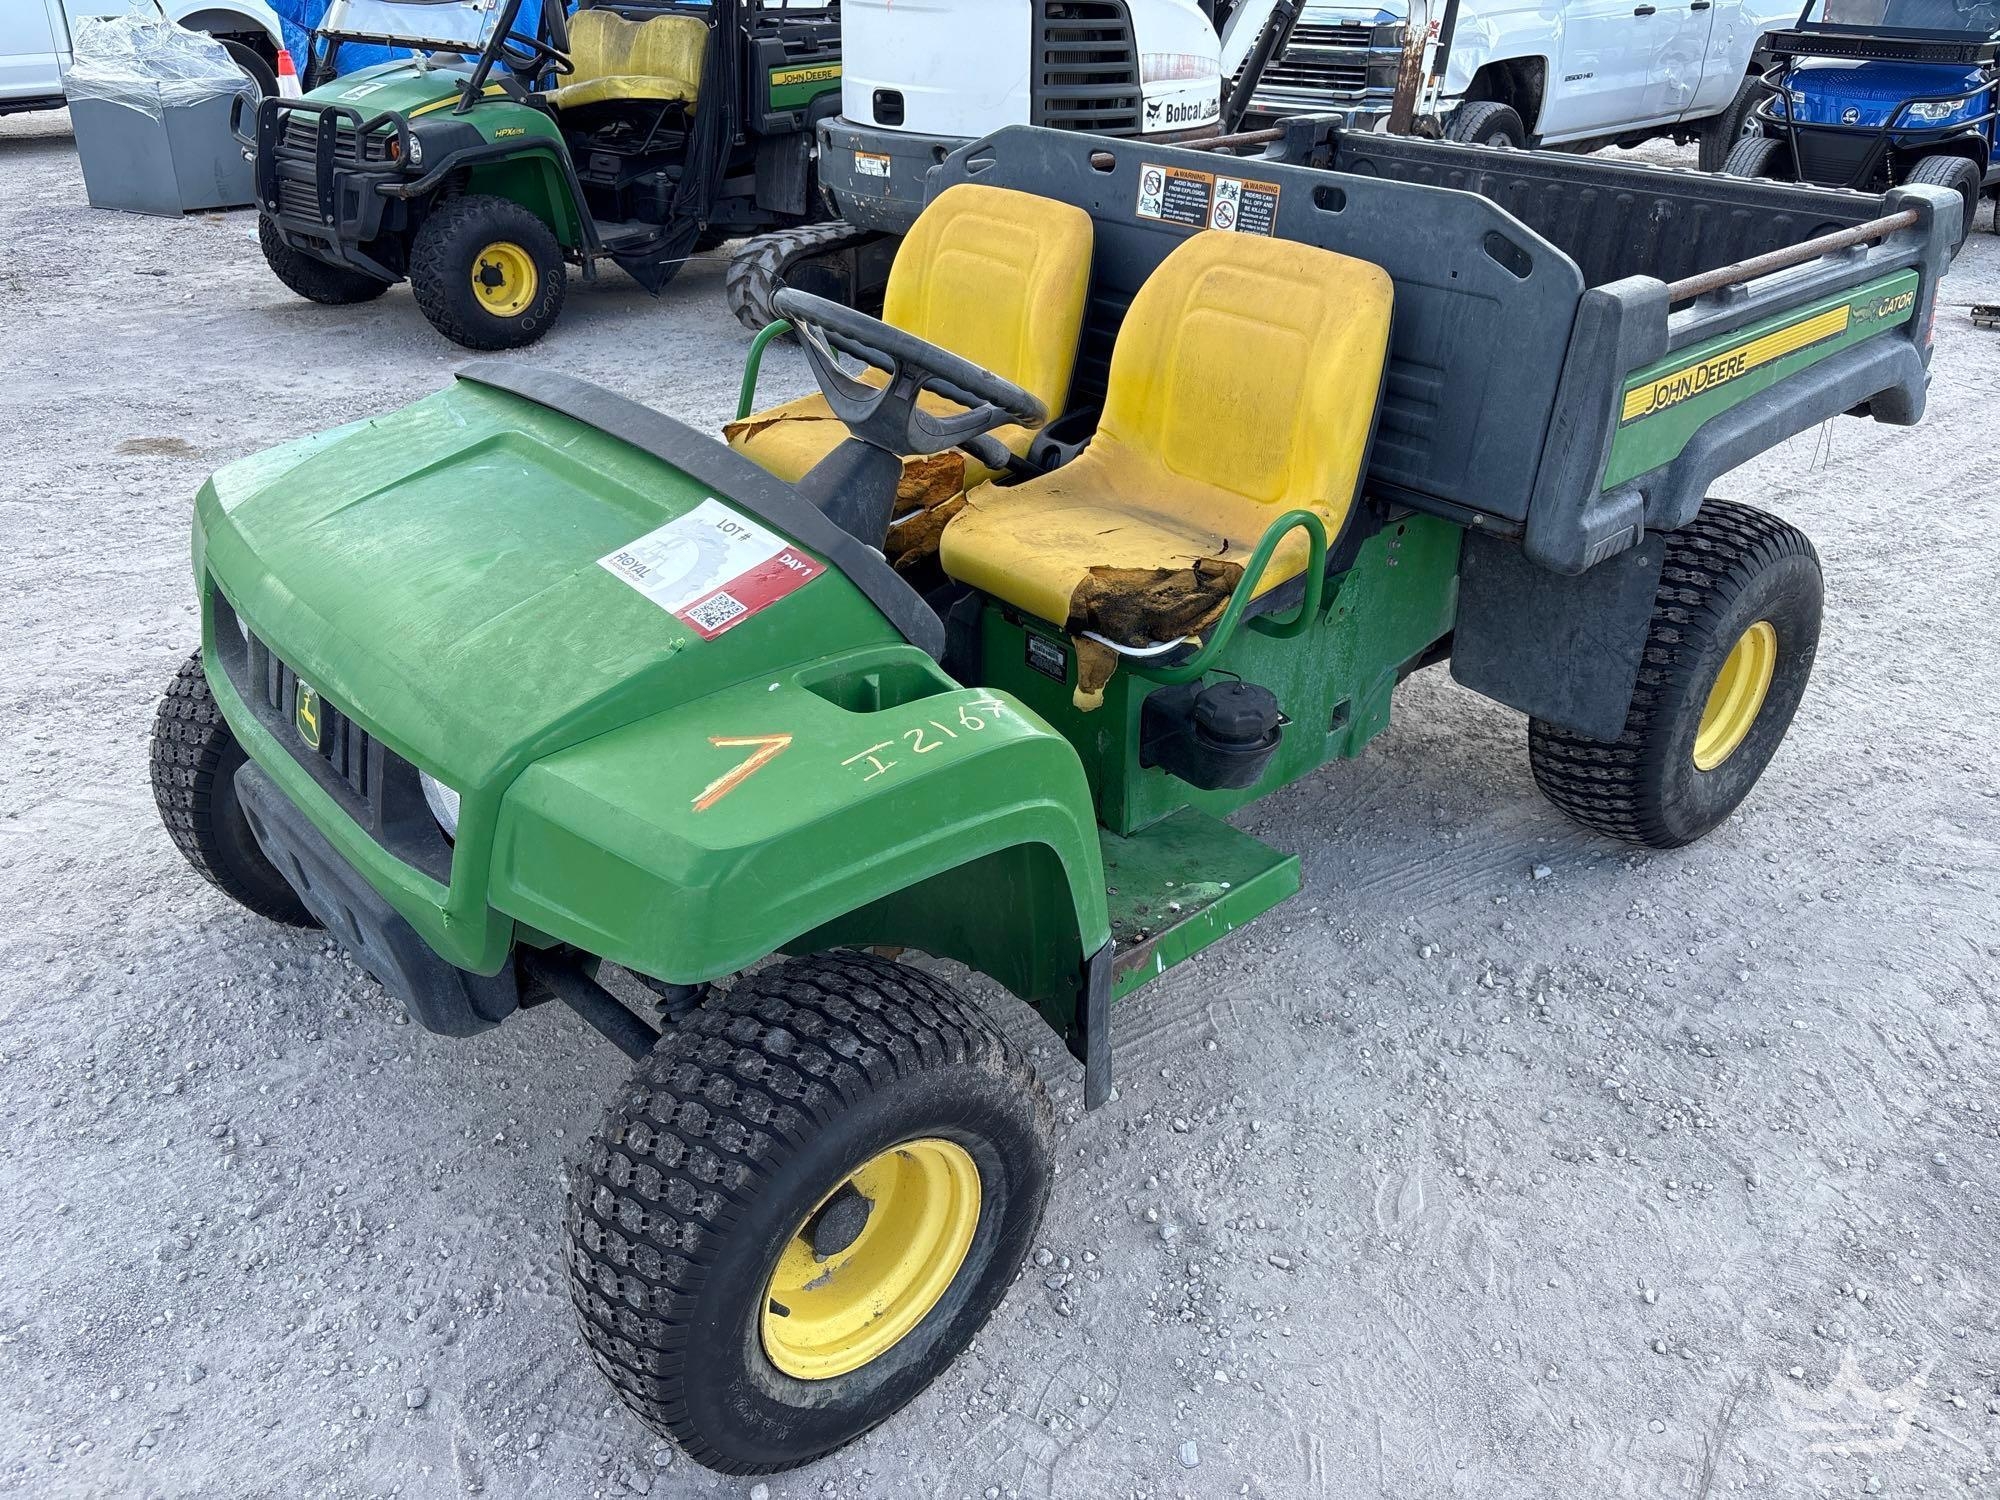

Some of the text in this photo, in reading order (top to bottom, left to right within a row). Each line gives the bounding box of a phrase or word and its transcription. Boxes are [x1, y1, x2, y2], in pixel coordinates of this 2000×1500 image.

[783, 70, 832, 84] JOHN DEERE
[1166, 101, 1202, 123] Bobcat
[1180, 171, 1206, 181] WARNING
[1250, 182, 1278, 193] WARNING
[1251, 207, 1268, 215] KILLED
[1878, 291, 1913, 317] GATOR
[1645, 353, 1747, 413] JOHN DEERE
[716, 519, 752, 541] LOT #
[613, 552, 651, 578] ROYAL
[778, 554, 812, 577] DAY 1
